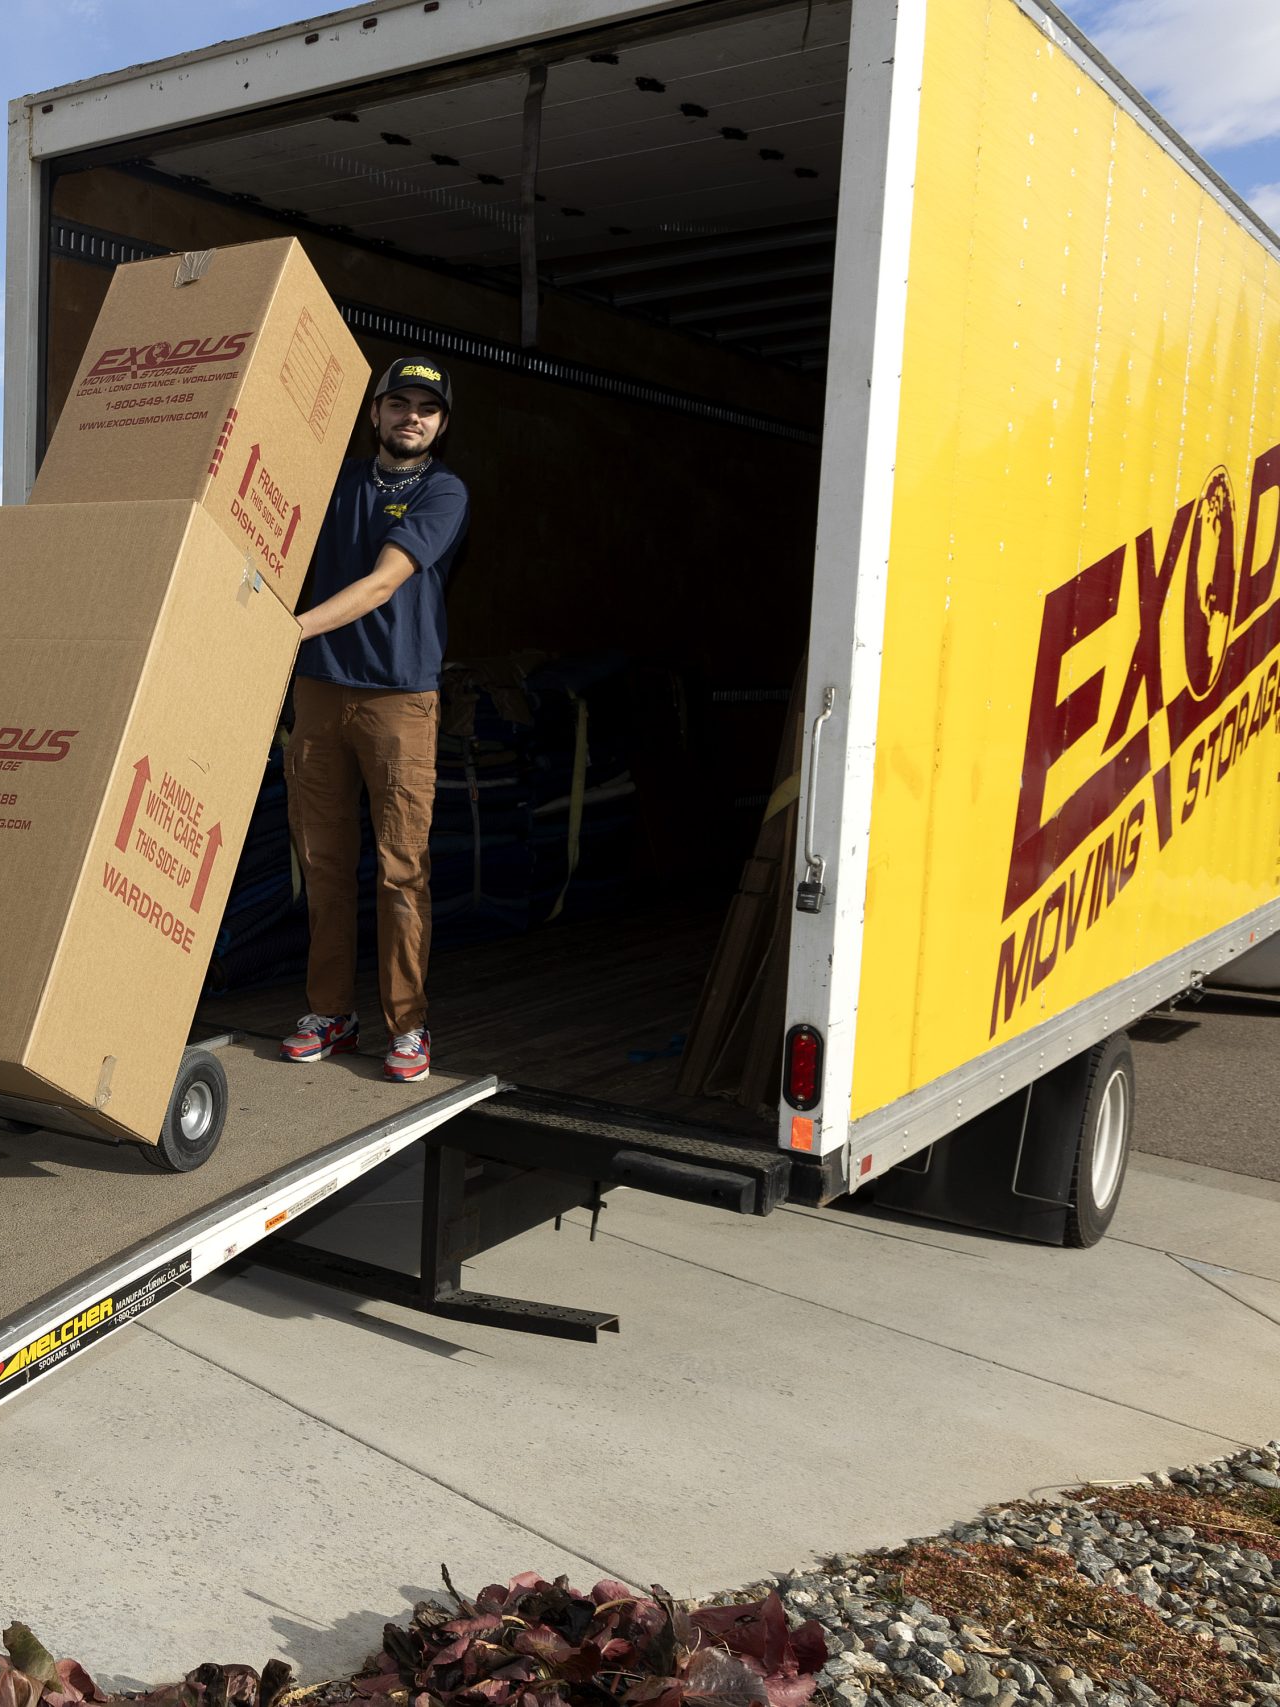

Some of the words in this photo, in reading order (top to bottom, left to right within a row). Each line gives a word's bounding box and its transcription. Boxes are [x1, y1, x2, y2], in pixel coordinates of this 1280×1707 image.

[80, 372, 127, 387] MOVING
[140, 365, 197, 380] STORAGE
[87, 331, 255, 379] EXODUS
[76, 386, 103, 397] LOCAL
[108, 383, 132, 393] LONG
[132, 379, 176, 391] DISTANCE
[182, 371, 239, 384] WORLDWIDE
[105, 393, 194, 411] 1-800-549-1488
[79, 411, 208, 431] WWW.EXODUSMOVING.COM
[250, 488, 263, 512] THIS
[261, 506, 276, 530] SIDE
[274, 522, 283, 538] UP
[257, 467, 289, 520] FRAGILE
[231, 499, 257, 540] DISH
[255, 533, 284, 578] PACK
[146, 790, 175, 833] WITH
[173, 817, 203, 859] CARE
[160, 771, 204, 828] HANDLE
[135, 828, 158, 863] THIS
[155, 846, 179, 880] SIDE
[176, 864, 192, 889] UP
[103, 861, 196, 954] WARDROBE
[989, 798, 1146, 1042] MOVING
[115, 1274, 167, 1311] MANUFACTURING
[179, 1260, 190, 1272] INC.
[70, 1339, 81, 1351] WA
